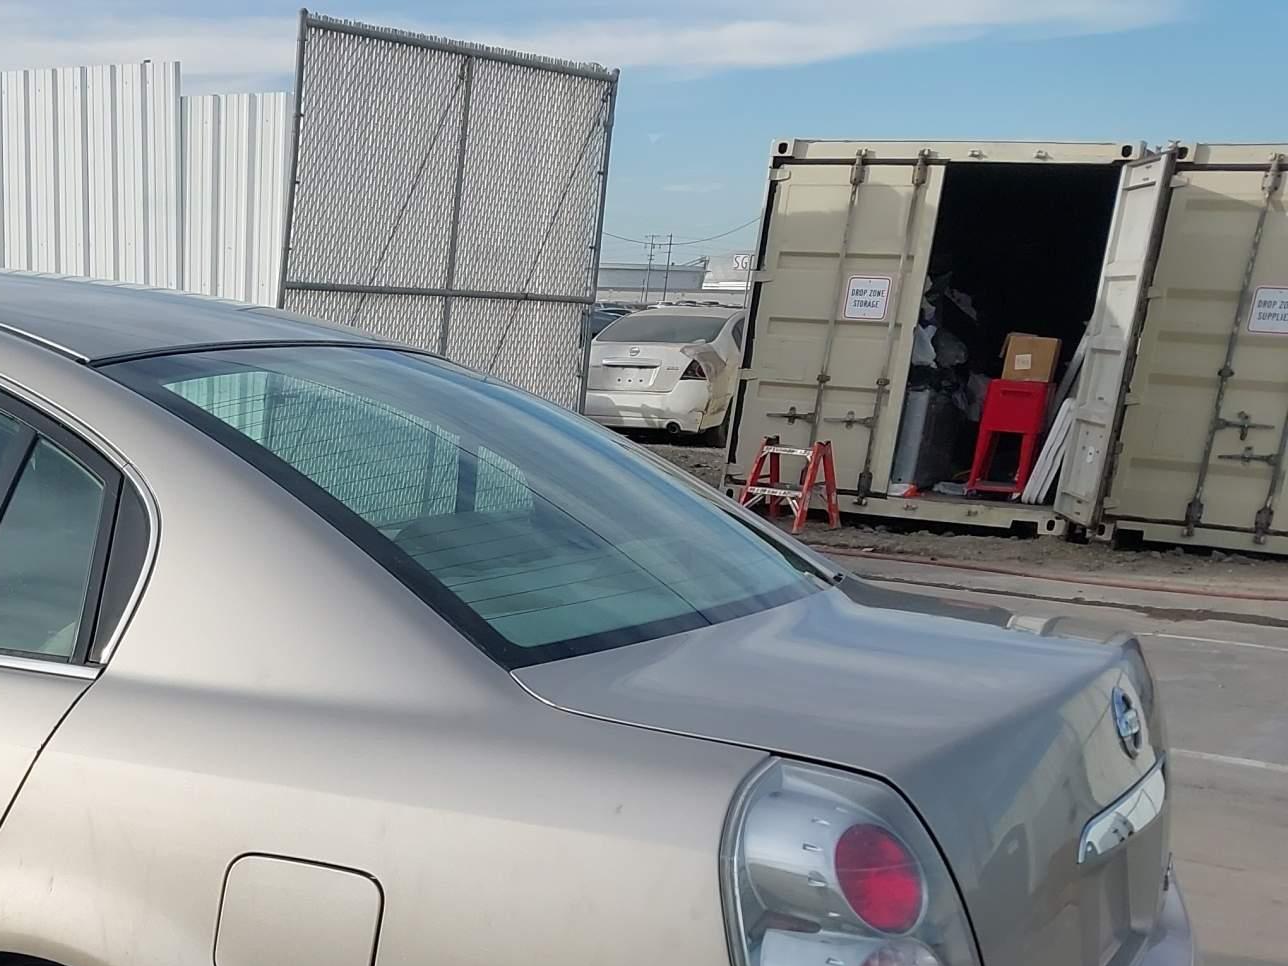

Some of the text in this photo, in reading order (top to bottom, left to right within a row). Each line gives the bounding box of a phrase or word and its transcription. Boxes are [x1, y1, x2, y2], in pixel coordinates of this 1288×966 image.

[851, 288, 886, 298] DROP ZONE
[853, 299, 880, 308] STORAGE
[1257, 300, 1277, 308] DROP
